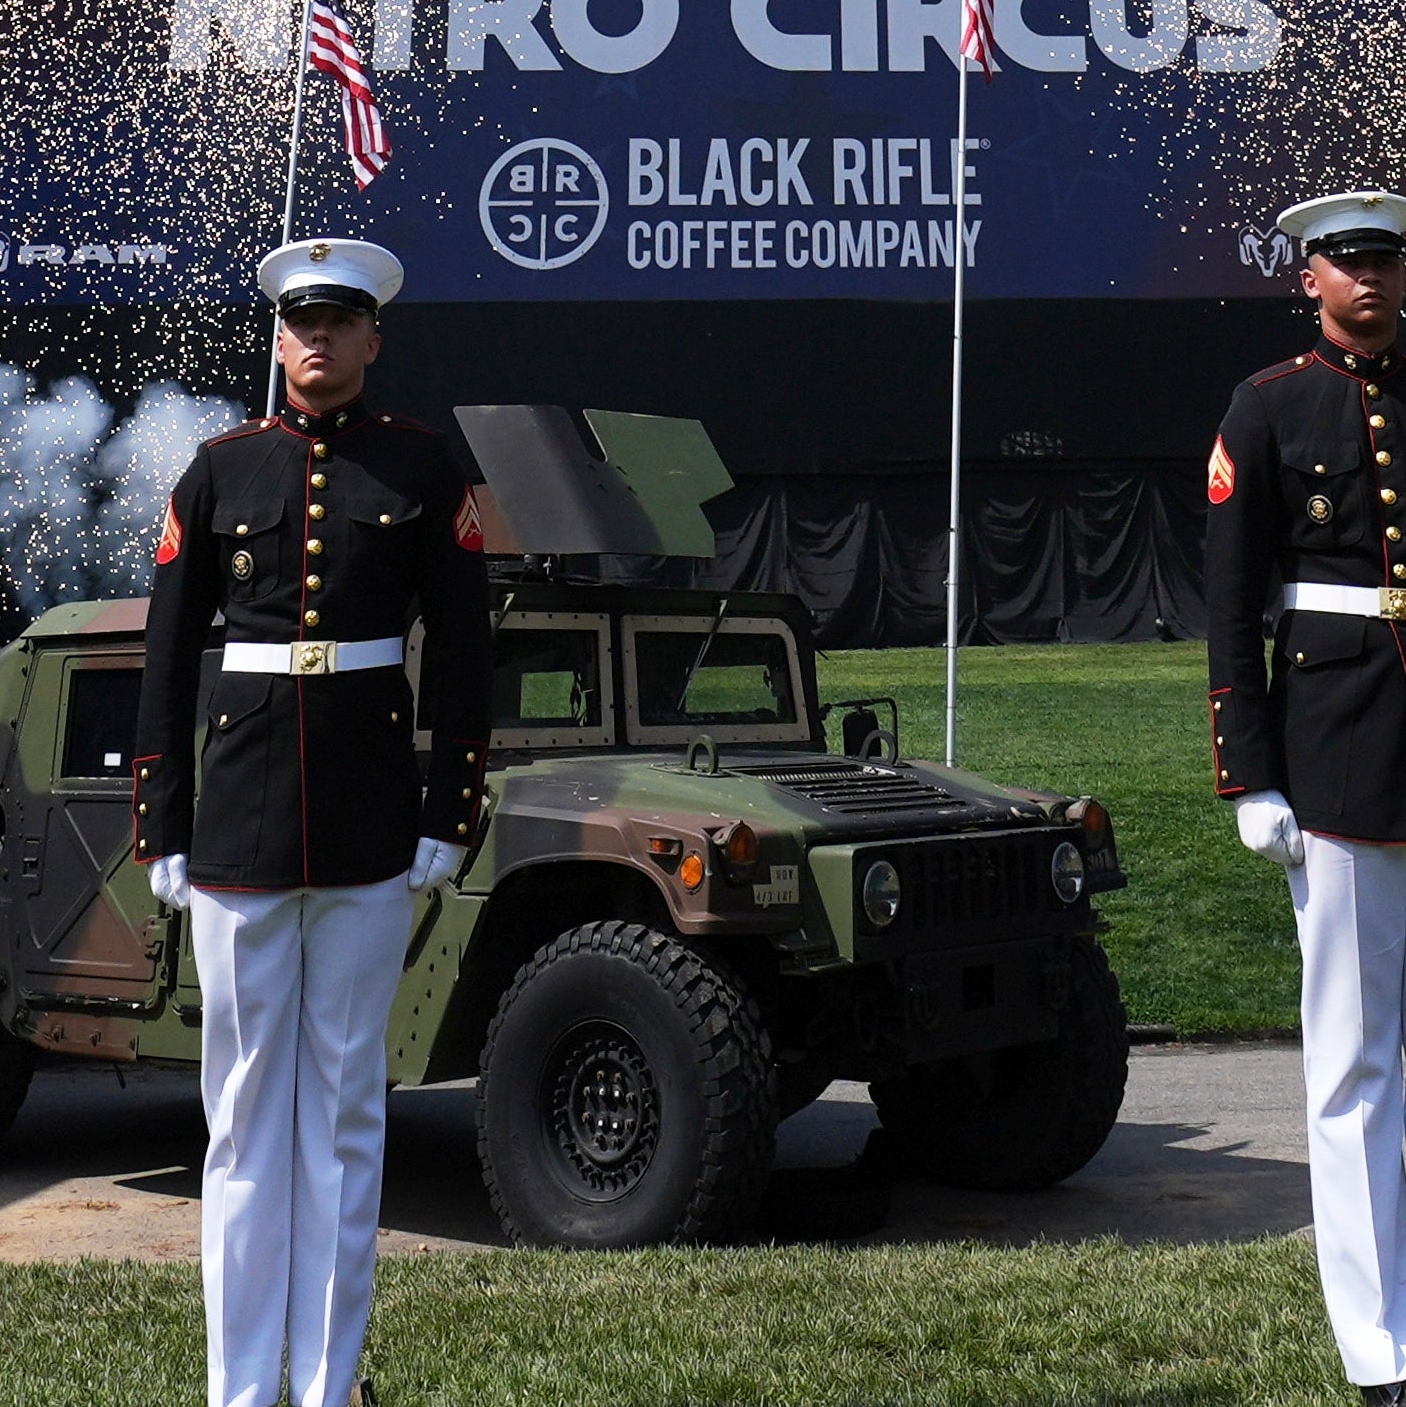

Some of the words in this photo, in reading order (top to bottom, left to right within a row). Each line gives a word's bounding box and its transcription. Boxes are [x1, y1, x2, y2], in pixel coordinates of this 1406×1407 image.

[628, 138, 814, 206] BLACK
[18, 244, 167, 264] RAM
[627, 221, 777, 269] COFFEE
[785, 220, 982, 268] COMPANY
